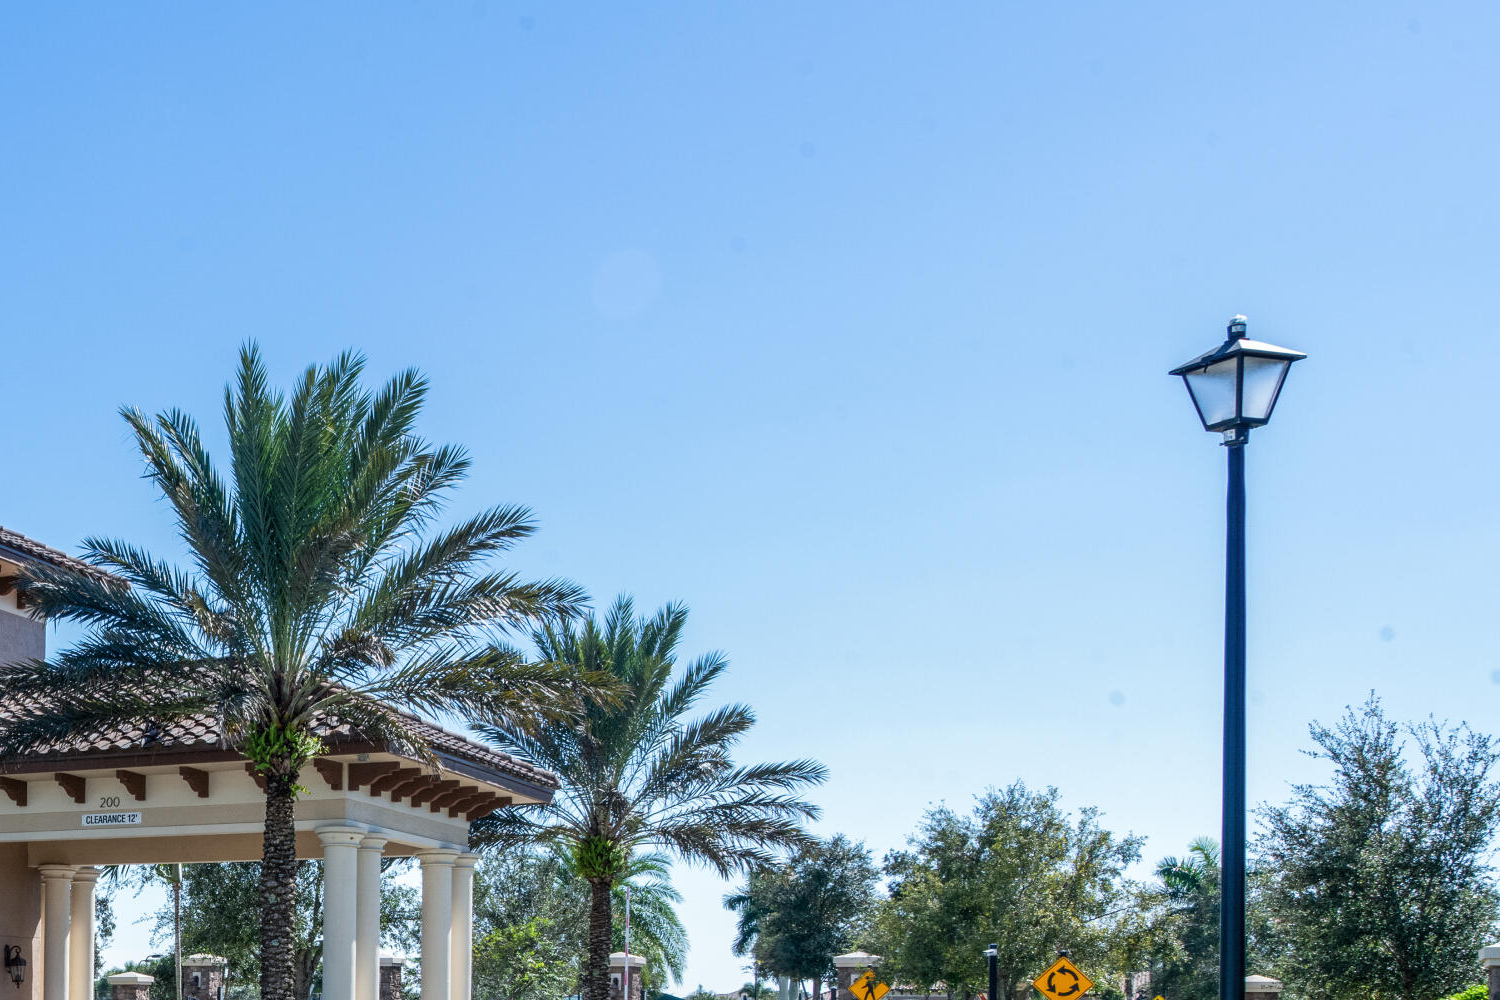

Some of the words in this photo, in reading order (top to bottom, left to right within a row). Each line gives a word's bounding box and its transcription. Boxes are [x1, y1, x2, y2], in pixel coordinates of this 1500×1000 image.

[100, 796, 120, 808] 200
[85, 814, 126, 825] CLEARANCE
[127, 813, 138, 823] 12'
